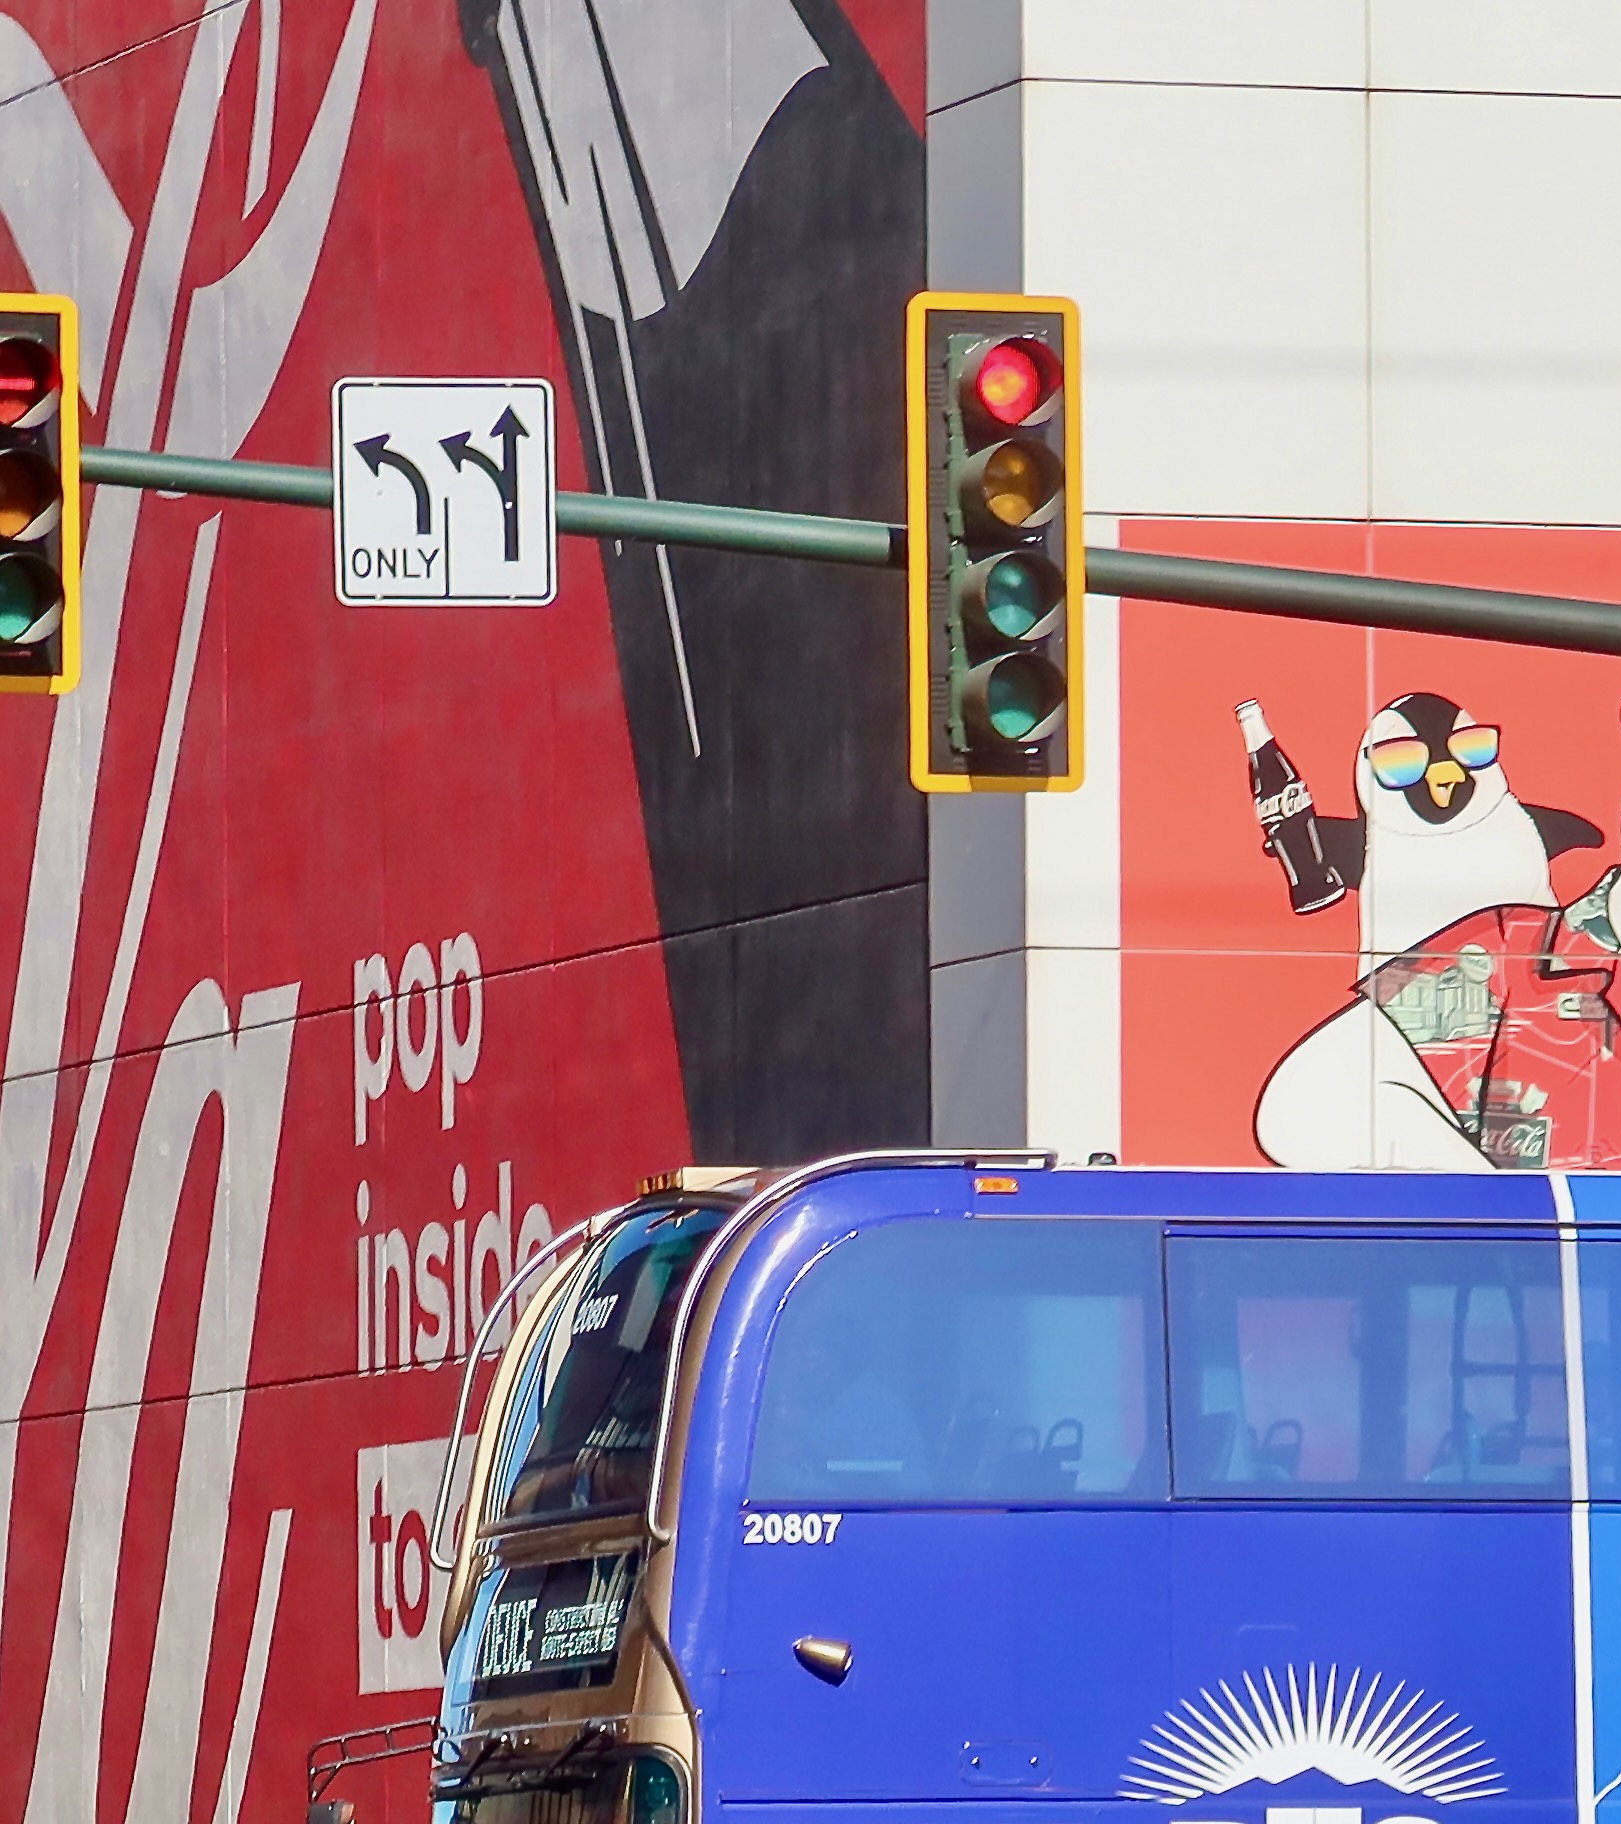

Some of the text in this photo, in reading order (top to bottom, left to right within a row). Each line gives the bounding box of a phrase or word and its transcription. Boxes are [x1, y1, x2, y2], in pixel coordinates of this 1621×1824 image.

[352, 548, 440, 578] ONLY
[354, 932, 483, 1146] pop
[356, 1160, 557, 1377] inside
[743, 1513, 843, 1545] 20807
